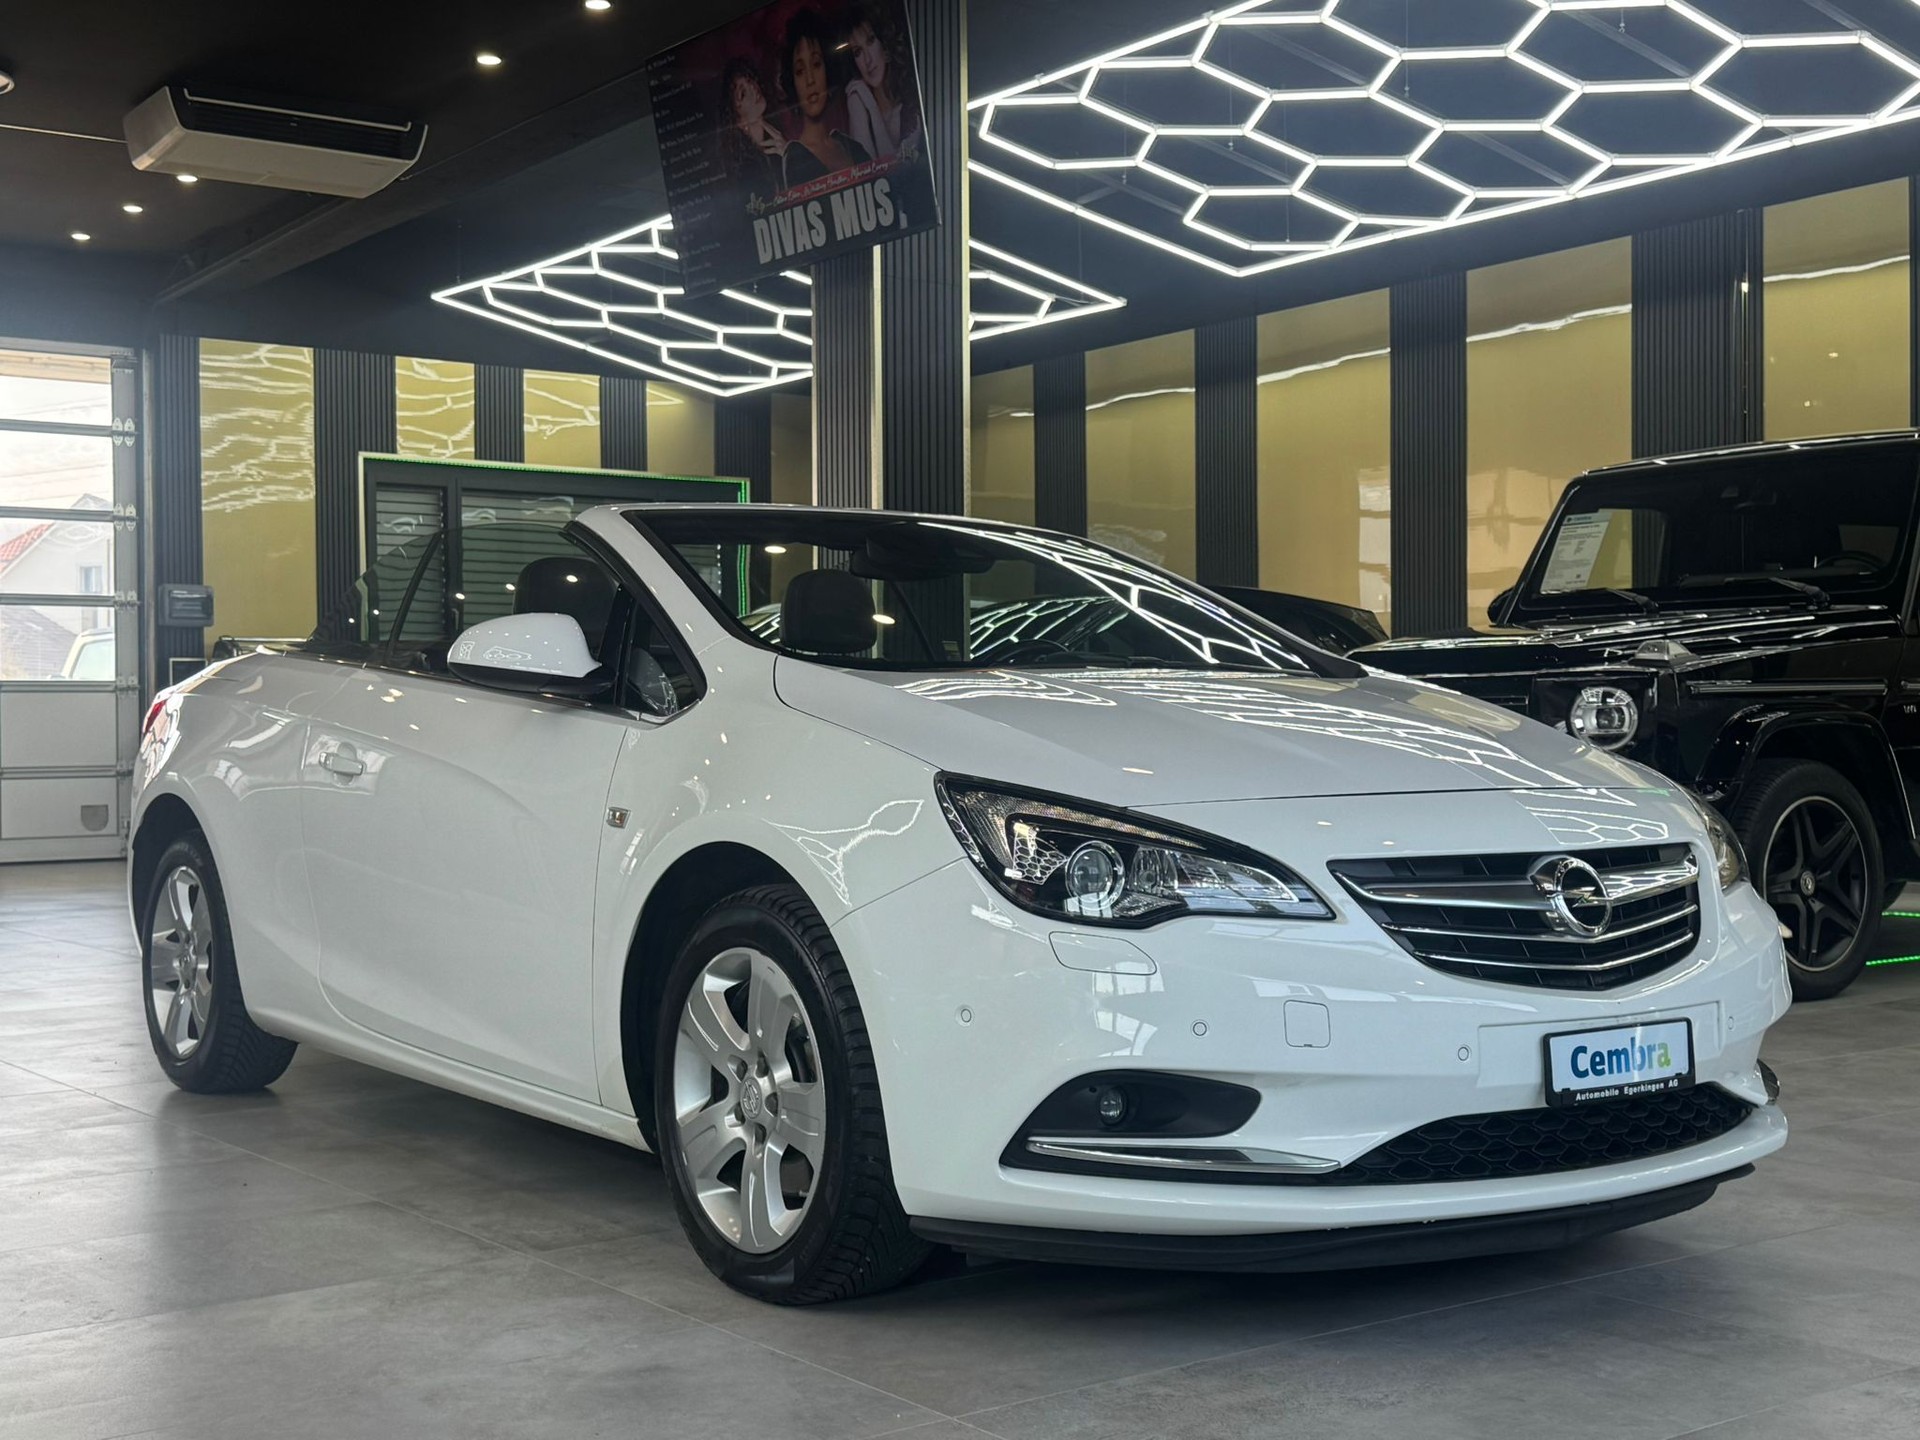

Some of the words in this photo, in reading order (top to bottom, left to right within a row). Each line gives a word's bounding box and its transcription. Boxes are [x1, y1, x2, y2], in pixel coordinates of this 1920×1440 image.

[753, 200, 827, 265] DIVAS
[1570, 1036, 1671, 1079] Cembra
[1575, 1088, 1620, 1101] Automobile
[1623, 1081, 1665, 1096] Egerkingen
[1667, 1079, 1679, 1088] AG
